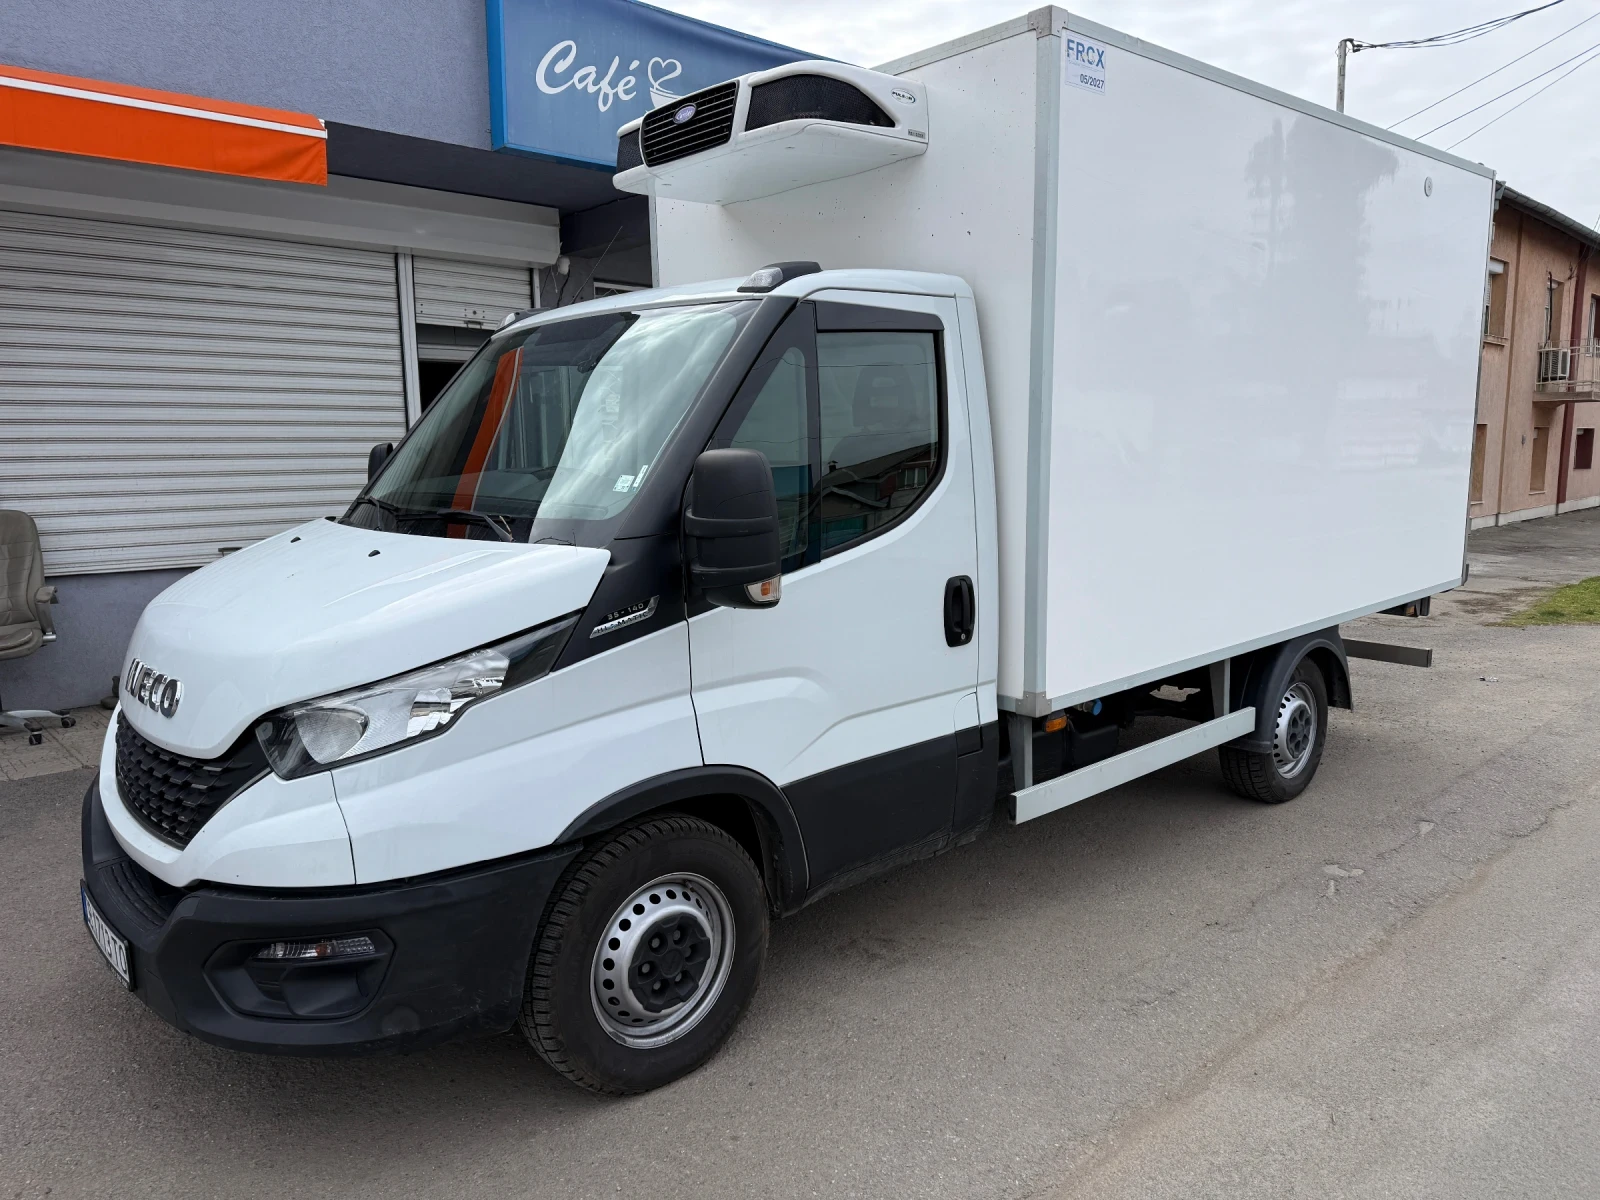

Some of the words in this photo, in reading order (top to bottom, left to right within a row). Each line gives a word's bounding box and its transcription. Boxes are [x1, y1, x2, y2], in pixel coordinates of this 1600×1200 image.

[535, 39, 640, 113] Café
[1079, 73, 1105, 90] 05/2027
[125, 657, 184, 719] IVECO
